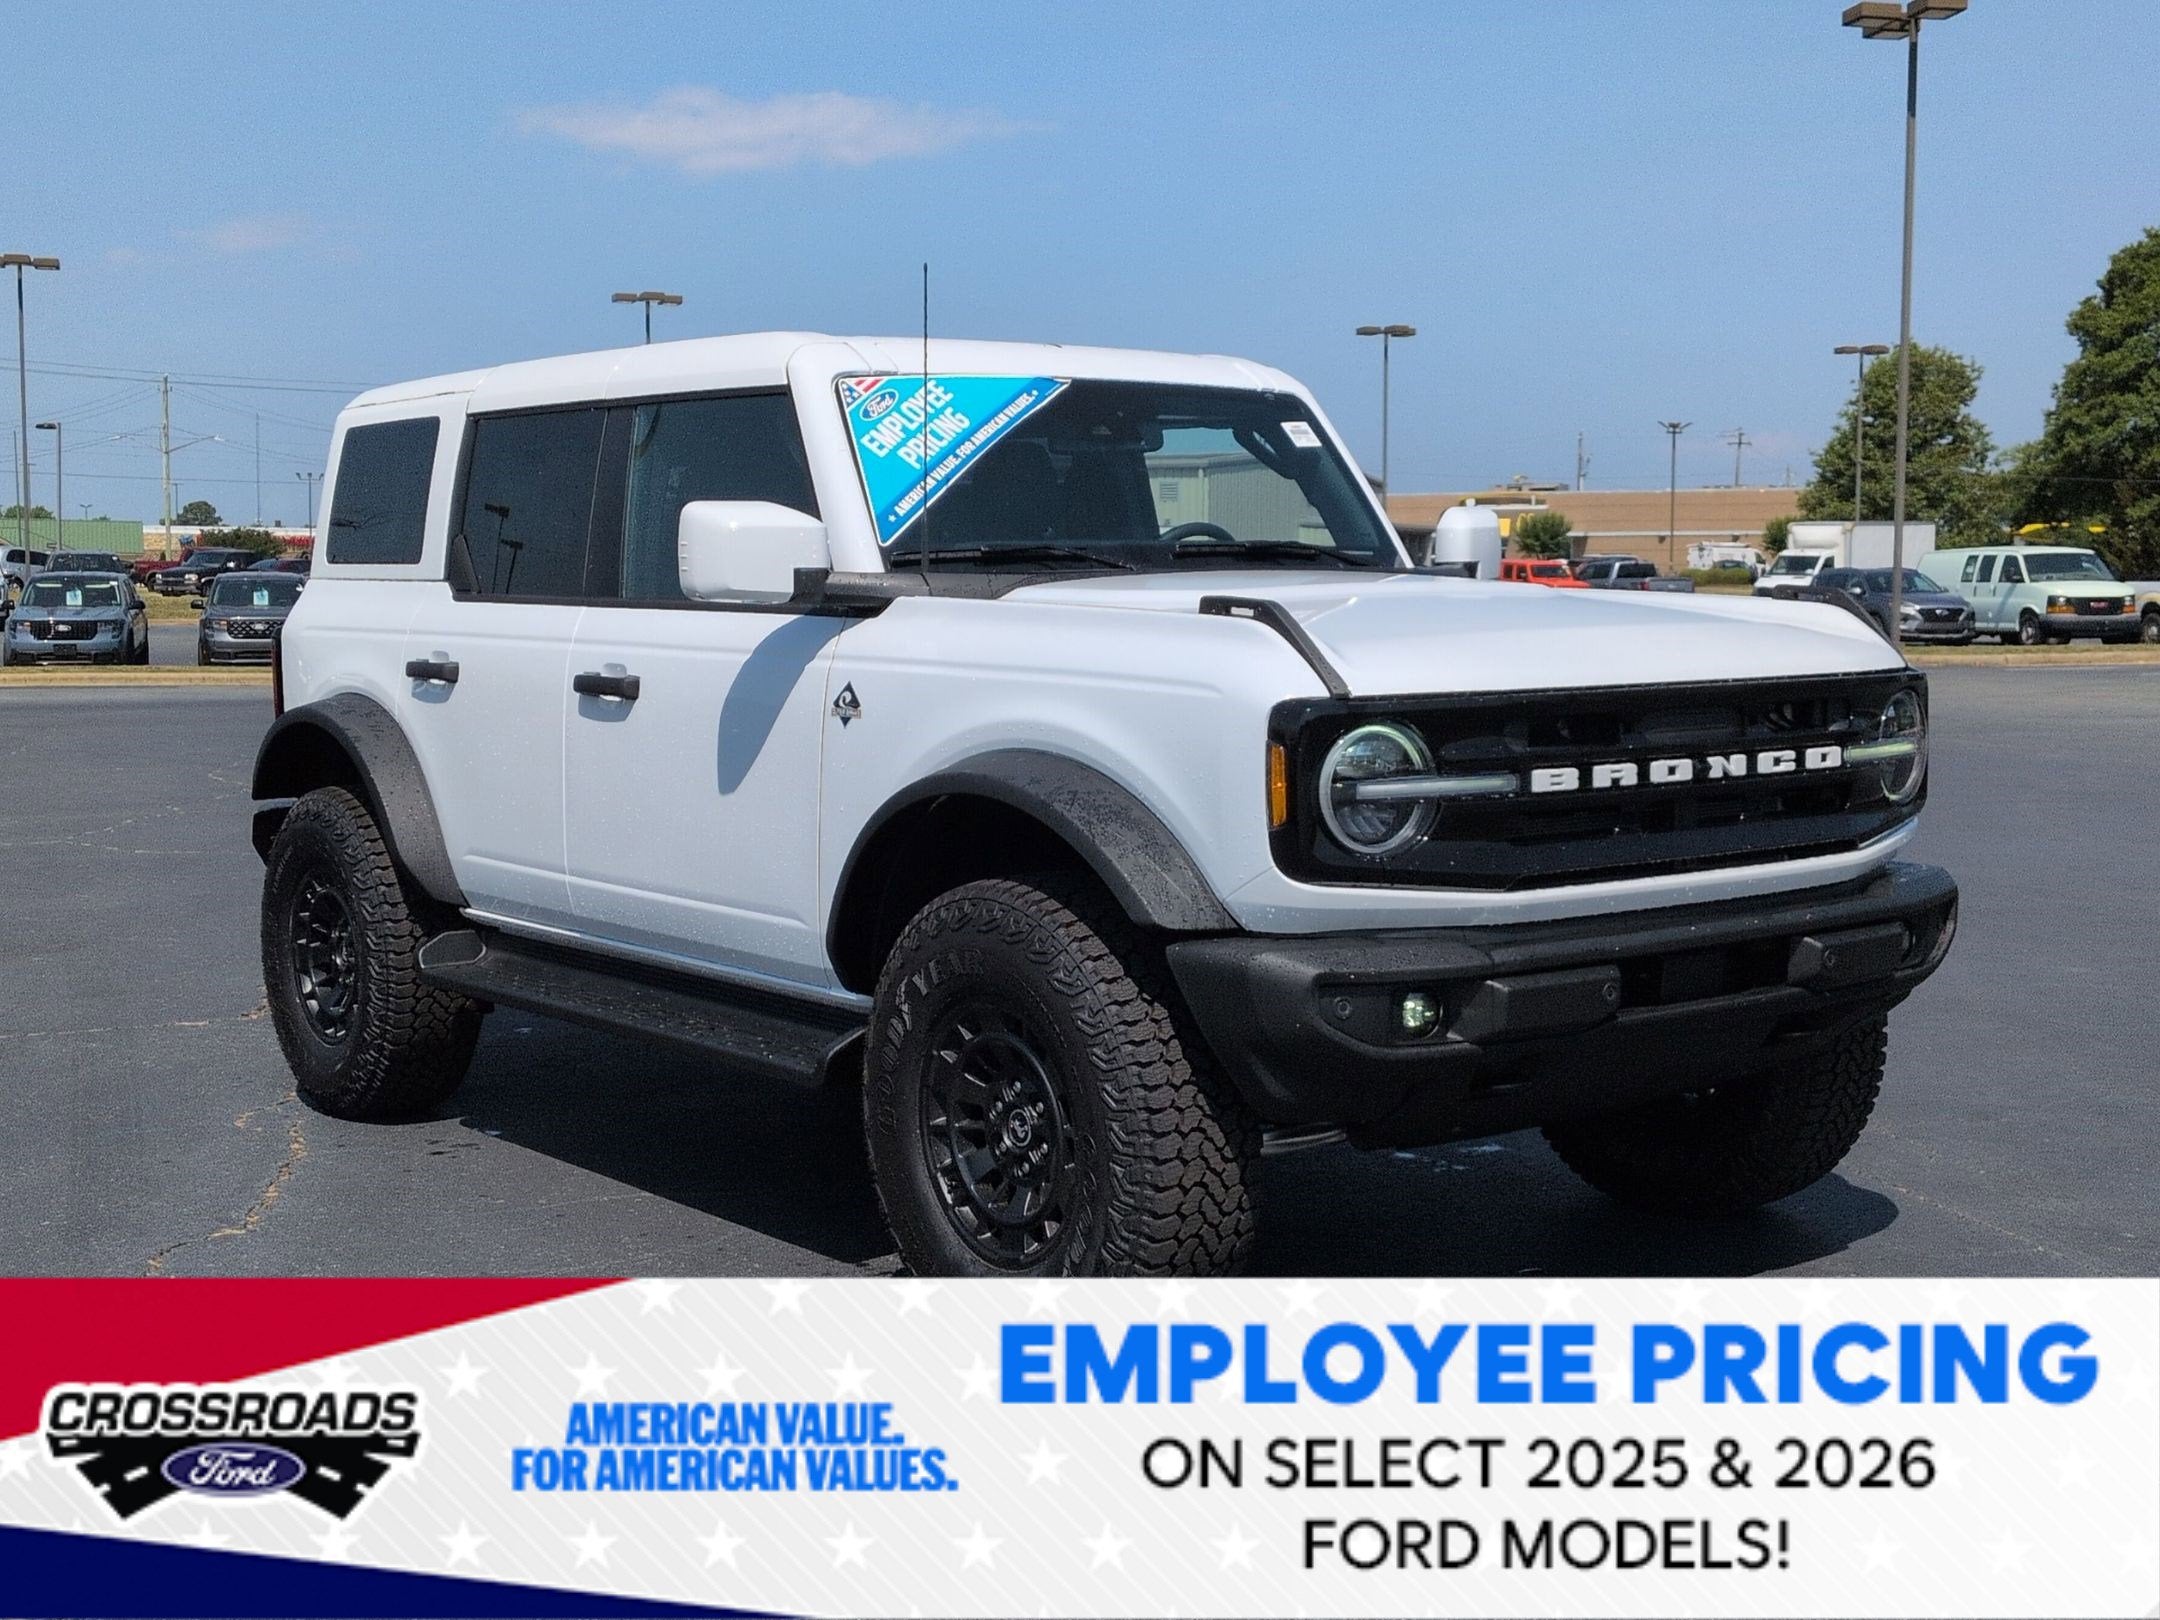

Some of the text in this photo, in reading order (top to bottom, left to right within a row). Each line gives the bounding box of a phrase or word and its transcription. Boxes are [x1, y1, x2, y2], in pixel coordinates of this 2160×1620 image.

[860, 379, 954, 458] EMPLOYEE
[896, 406, 971, 470] PRICING
[894, 473, 938, 516] AMERICAN
[955, 440, 977, 459] FOR
[970, 411, 1011, 447] AMERICAN
[1530, 745, 1843, 793] BRONCO
